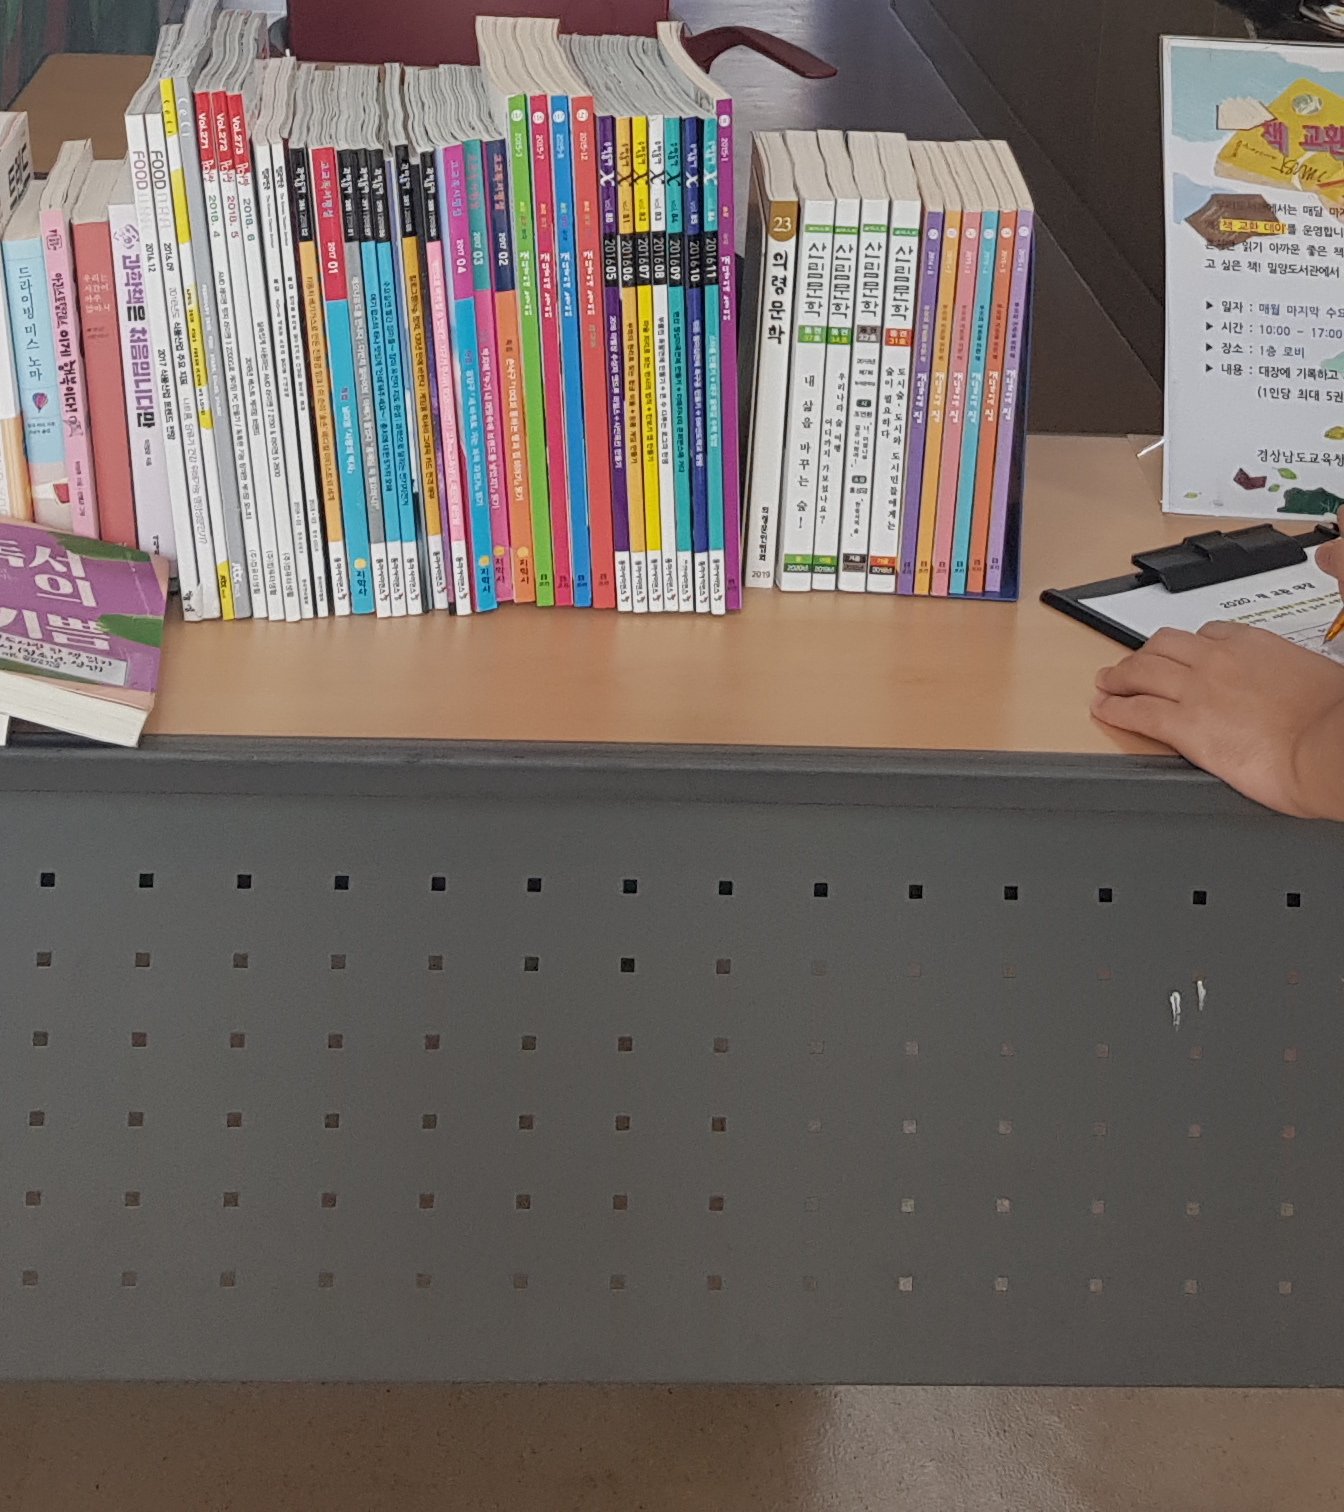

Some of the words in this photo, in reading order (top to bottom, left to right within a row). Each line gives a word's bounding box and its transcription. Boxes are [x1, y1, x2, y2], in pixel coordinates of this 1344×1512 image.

[1262, 121, 1289, 157] 책
[133, 150, 150, 190] FOOD
[150, 150, 167, 190] FOOD
[198, 113, 209, 150] Vol.271
[209, 195, 219, 226] 2018.
[216, 113, 228, 152] Vol.272
[227, 195, 237, 226] 2018.
[231, 115, 244, 155] Vol.273
[242, 198, 253, 229] 2018.
[773, 216, 792, 232] 23
[1303, 206, 1323, 218] 매달
[327, 242, 336, 259] 2017
[472, 250, 483, 266] 03
[498, 251, 509, 267] 02
[1242, 240, 1263, 253] 읽기
[1269, 243, 1300, 255] 아까운
[1307, 245, 1327, 258] 좋은
[327, 261, 339, 274] 01
[456, 258, 467, 274] 04
[861, 242, 882, 317] 산림문학
[1205, 258, 1216, 270] 고
[1221, 259, 1242, 272] 싶은
[1247, 261, 1261, 273] 책!
[1267, 262, 1340, 279] 밀양도서관에서
[18, 266, 34, 319] 드라이빙
[121, 254, 146, 322] 과학책은
[804, 242, 827, 318] 산림문학
[832, 244, 854, 319] 산림문학
[891, 246, 913, 321] 산림문학
[1221, 300, 1243, 313] 일자
[1259, 302, 1280, 317] 매월
[1287, 304, 1319, 318] 마지막
[25, 325, 40, 350] 미스
[59, 330, 73, 357] 이게
[1221, 322, 1244, 334] 시간
[1260, 324, 1291, 336] 10:00
[1311, 326, 1343, 339] 17:00
[157, 349, 167, 367] 2017
[1221, 343, 1244, 355] 장소
[1260, 345, 1277, 357] 1층
[1283, 346, 1305, 359] 로비
[29, 354, 44, 382] 노마
[129, 327, 156, 429] 처음입니다만
[804, 375, 815, 387] 내
[1221, 363, 1243, 376] 내용
[1259, 365, 1291, 380] 대장에
[1296, 367, 1339, 380] 기록하고
[62, 361, 79, 413] 행복이다!
[1257, 385, 1291, 400] (1인당
[1297, 388, 1320, 401] 최대
[802, 400, 813, 429] 삶을
[892, 413, 903, 445] 도시와
[797, 441, 811, 487] 바꾸는
[1257, 448, 1344, 467] 경상남도교육청
[34, 573, 98, 608] 의
